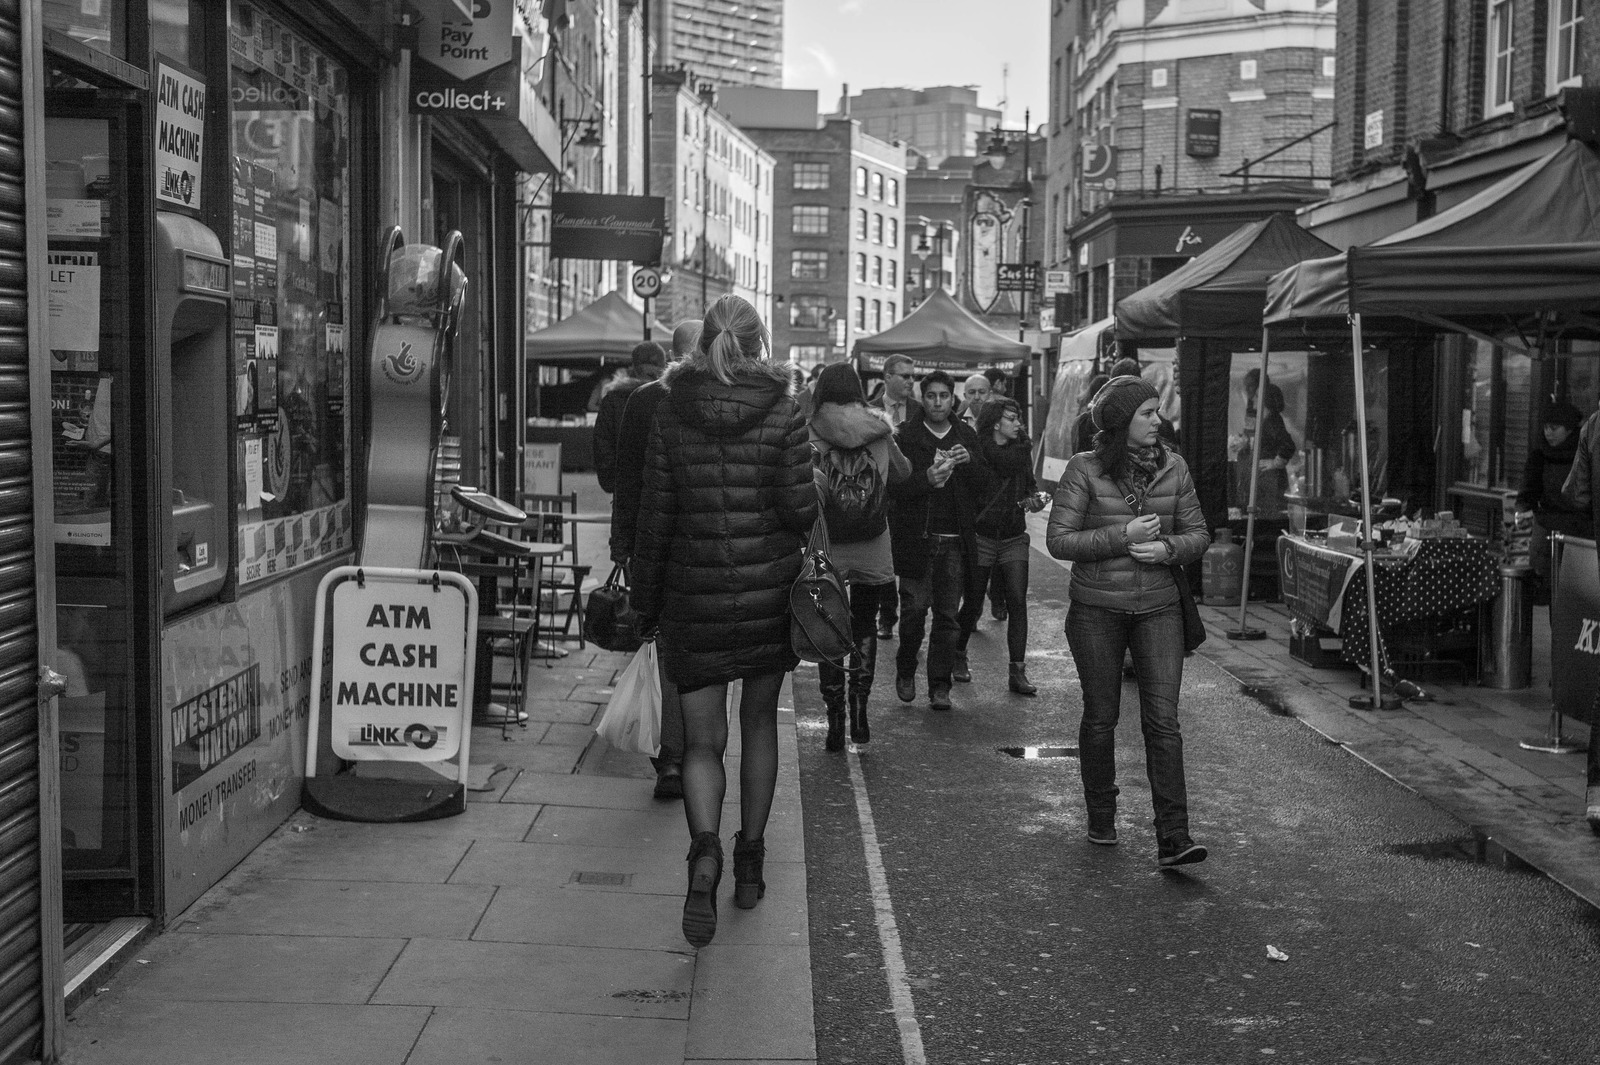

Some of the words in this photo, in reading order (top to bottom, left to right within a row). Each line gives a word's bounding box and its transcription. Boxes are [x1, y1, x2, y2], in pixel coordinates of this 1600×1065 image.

[441, 27, 474, 47] Pay
[440, 44, 489, 60] Point
[158, 73, 179, 110] ATM
[182, 84, 205, 121] CASH
[416, 87, 506, 111] collect+
[158, 120, 200, 163] MACHINE
[50, 270, 76, 283] LET
[636, 275, 657, 288] 20
[366, 604, 431, 630] ATM
[360, 643, 438, 669] CASH
[281, 665, 298, 694] SEND
[337, 681, 458, 708] MACHINE
[172, 668, 249, 748] WESTERN
[199, 709, 248, 771] UNION
[179, 789, 213, 833] MONEY
[216, 758, 257, 802] TRANSFER
